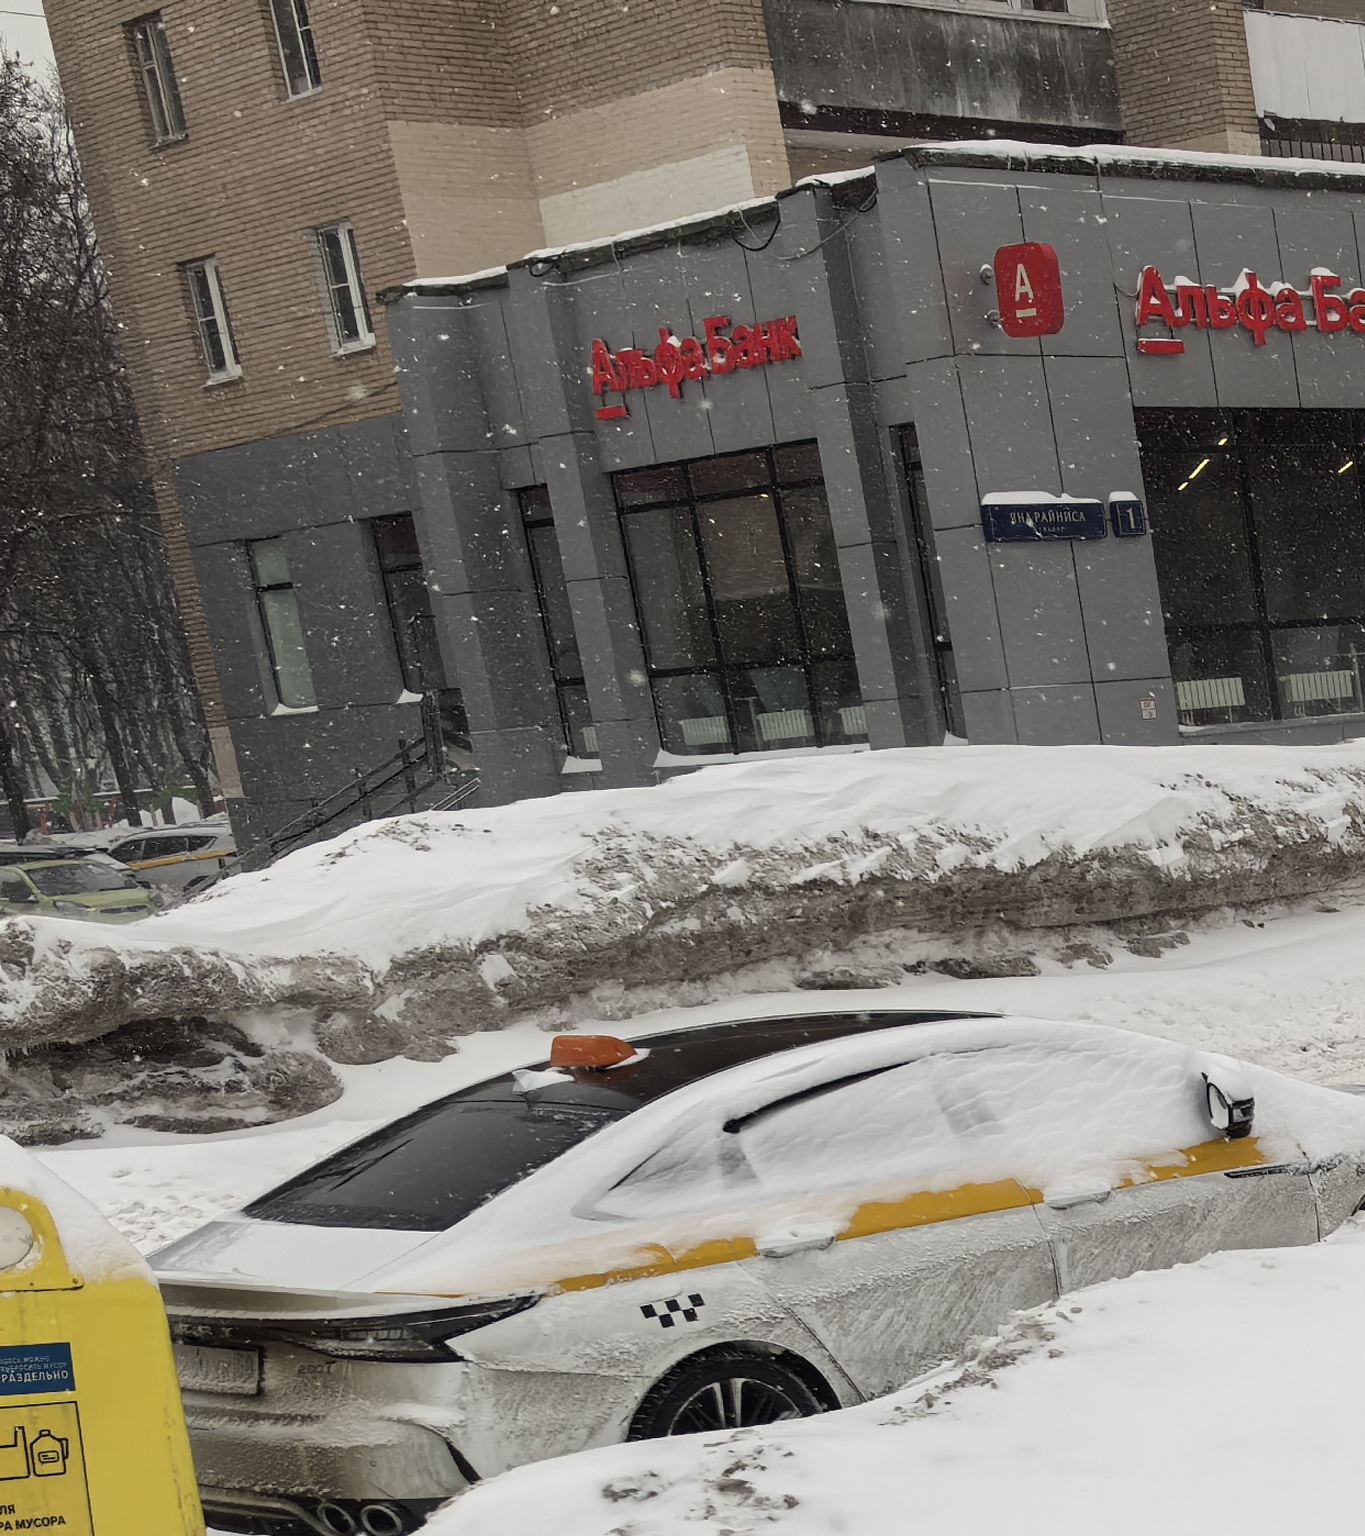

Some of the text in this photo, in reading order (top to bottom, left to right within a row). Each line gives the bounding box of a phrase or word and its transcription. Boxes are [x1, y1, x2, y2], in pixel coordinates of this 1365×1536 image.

[1034, 510, 1086, 523] РАЙНИСА
[1126, 508, 1136, 529] 1
[2, 1370, 68, 1383] РАЗДЕЛЬНО
[0, 1504, 16, 1515] ЛЯ
[15, 1515, 66, 1530] МУСОРА
